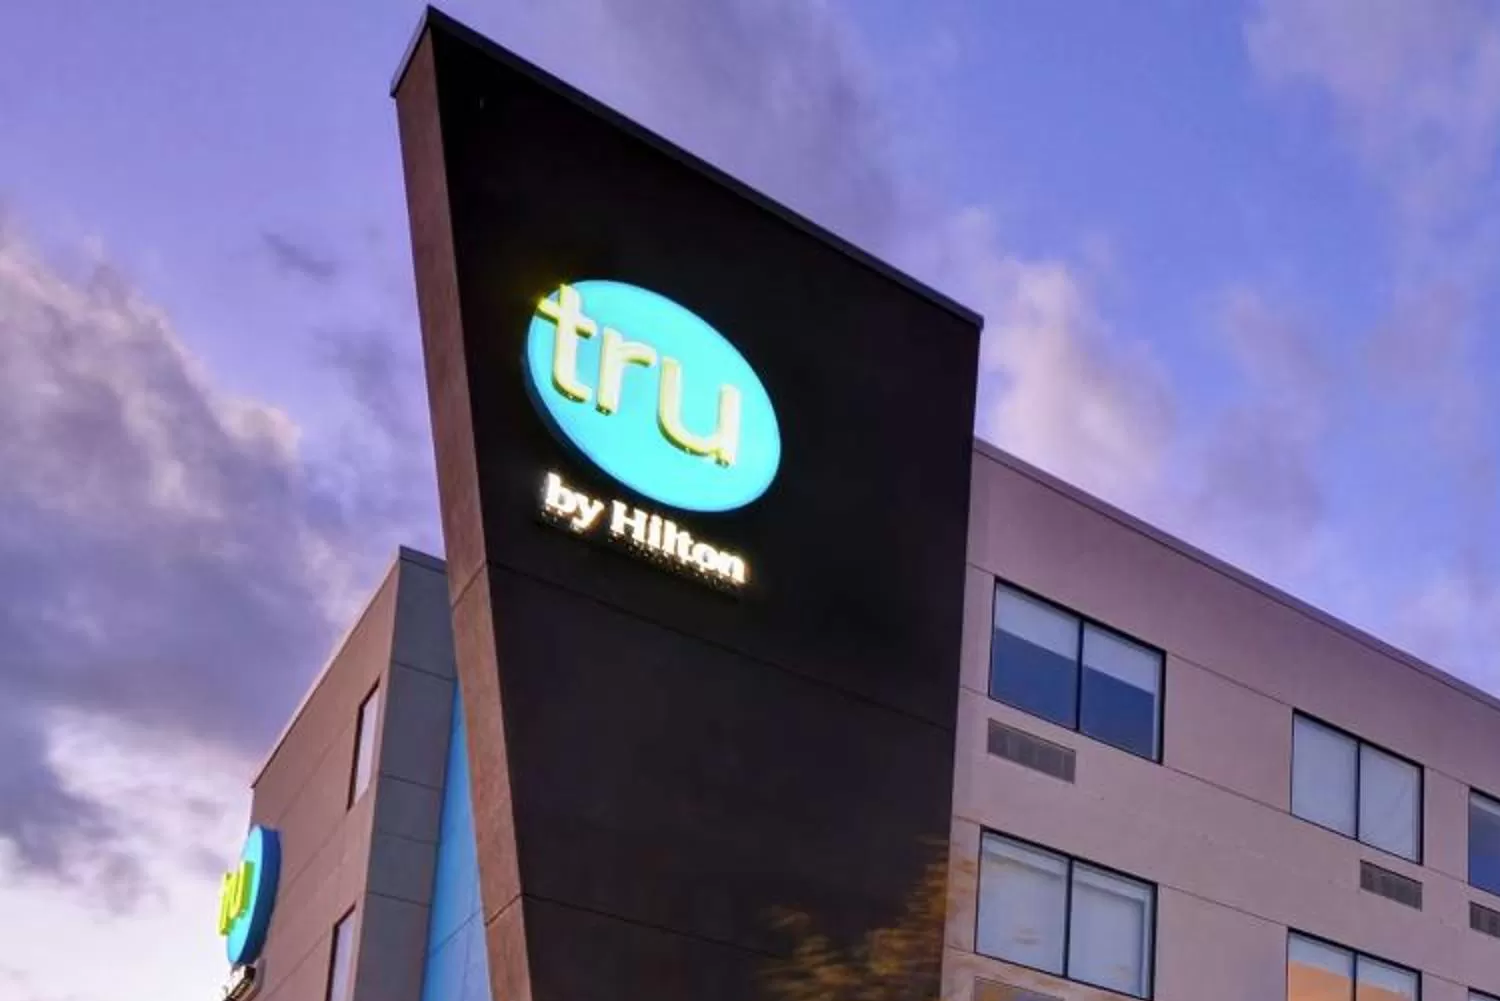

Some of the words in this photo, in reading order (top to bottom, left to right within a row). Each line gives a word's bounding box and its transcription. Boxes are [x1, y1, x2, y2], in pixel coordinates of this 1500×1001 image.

[536, 284, 741, 467] tru
[545, 472, 604, 533] by
[609, 500, 746, 584] Hilton
